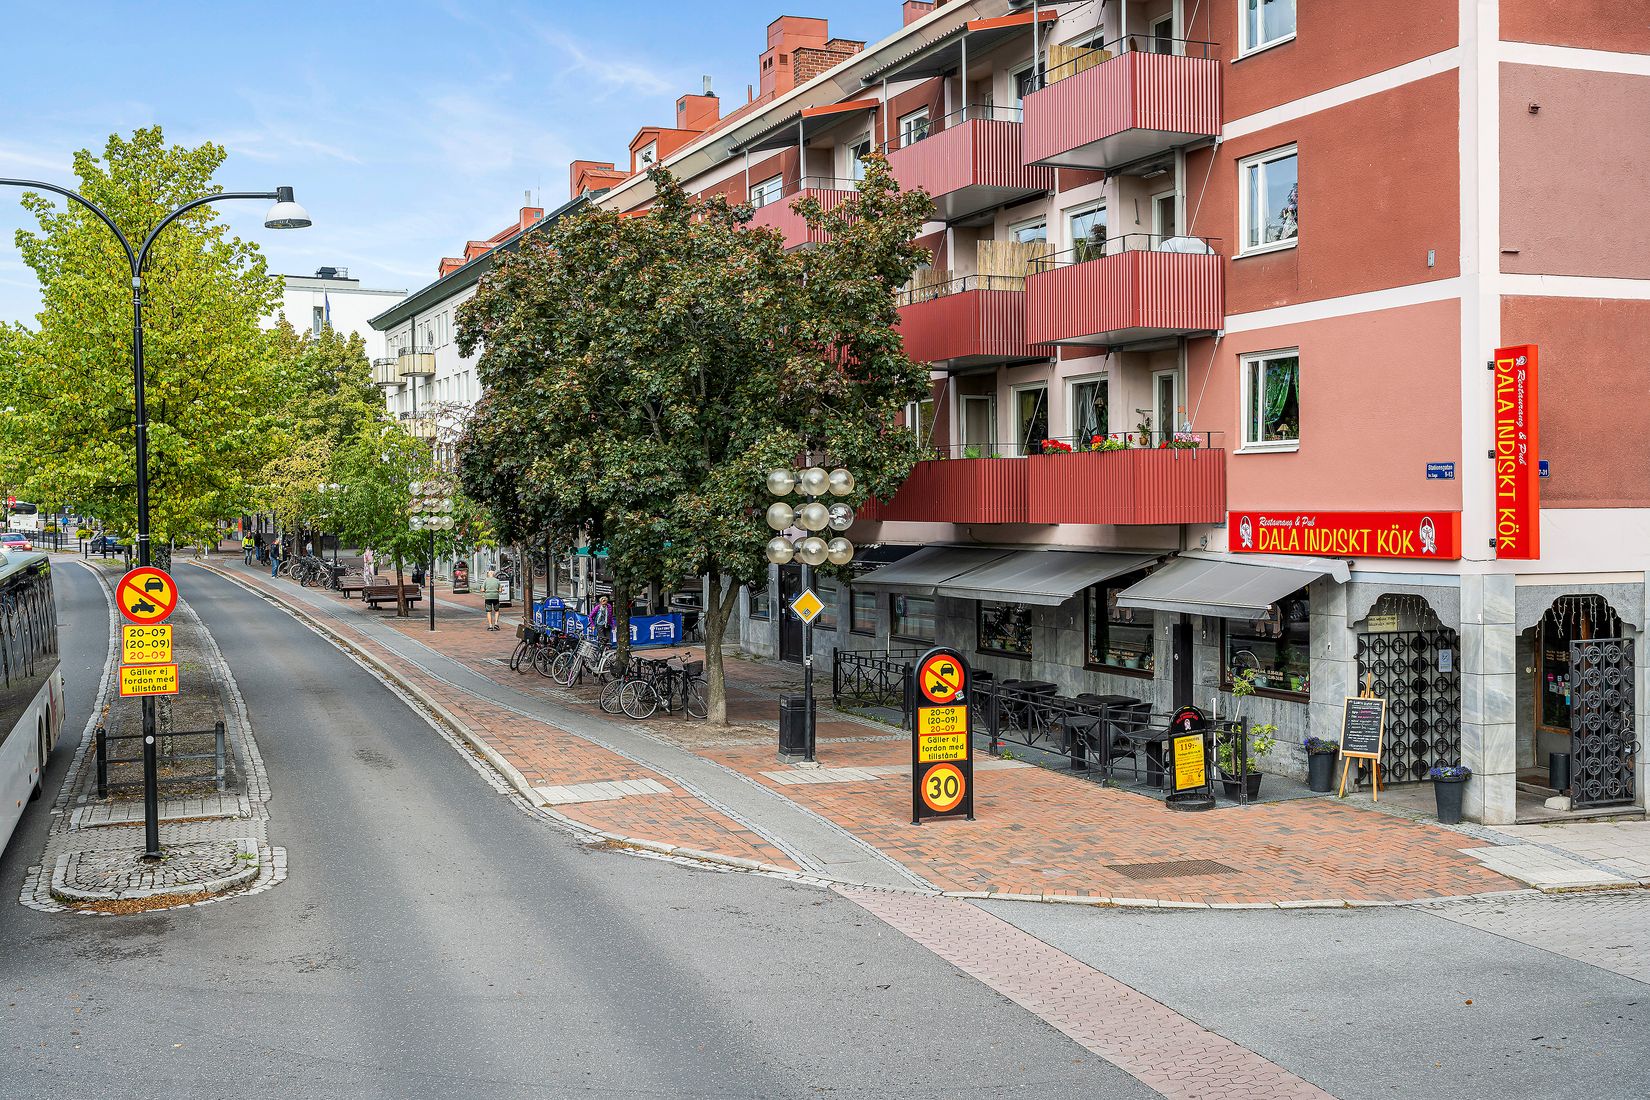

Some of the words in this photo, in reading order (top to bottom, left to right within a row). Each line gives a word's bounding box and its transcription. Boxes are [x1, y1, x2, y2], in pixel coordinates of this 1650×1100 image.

[1496, 358, 1515, 413] DALA
[1516, 369, 1526, 427] Restaurang
[1518, 431, 1527, 440] &
[1518, 443, 1527, 466] Pub
[1497, 419, 1516, 502] INDISKT
[1259, 516, 1293, 529] Restaurang
[1294, 515, 1301, 526] &
[1301, 515, 1316, 527] Pub
[1498, 508, 1520, 549] KÖK
[1259, 527, 1299, 550] DALA
[1304, 528, 1372, 553] INDISKT
[1377, 524, 1415, 555] KÖK
[129, 628, 166, 637] 20-09
[126, 639, 170, 649] (20-09)
[129, 651, 166, 660] 20-09
[130, 668, 157, 676] Gäller
[159, 667, 168, 676] ej
[124, 677, 154, 685] fordon
[156, 675, 175, 683] med
[131, 684, 168, 692] tillstånd
[930, 708, 955, 716] 20-09
[927, 716, 958, 725] (20-09)
[927, 736, 949, 744] Gäller
[951, 735, 959, 743] ej
[928, 752, 958, 760] tillstånd
[929, 775, 958, 799] 30
